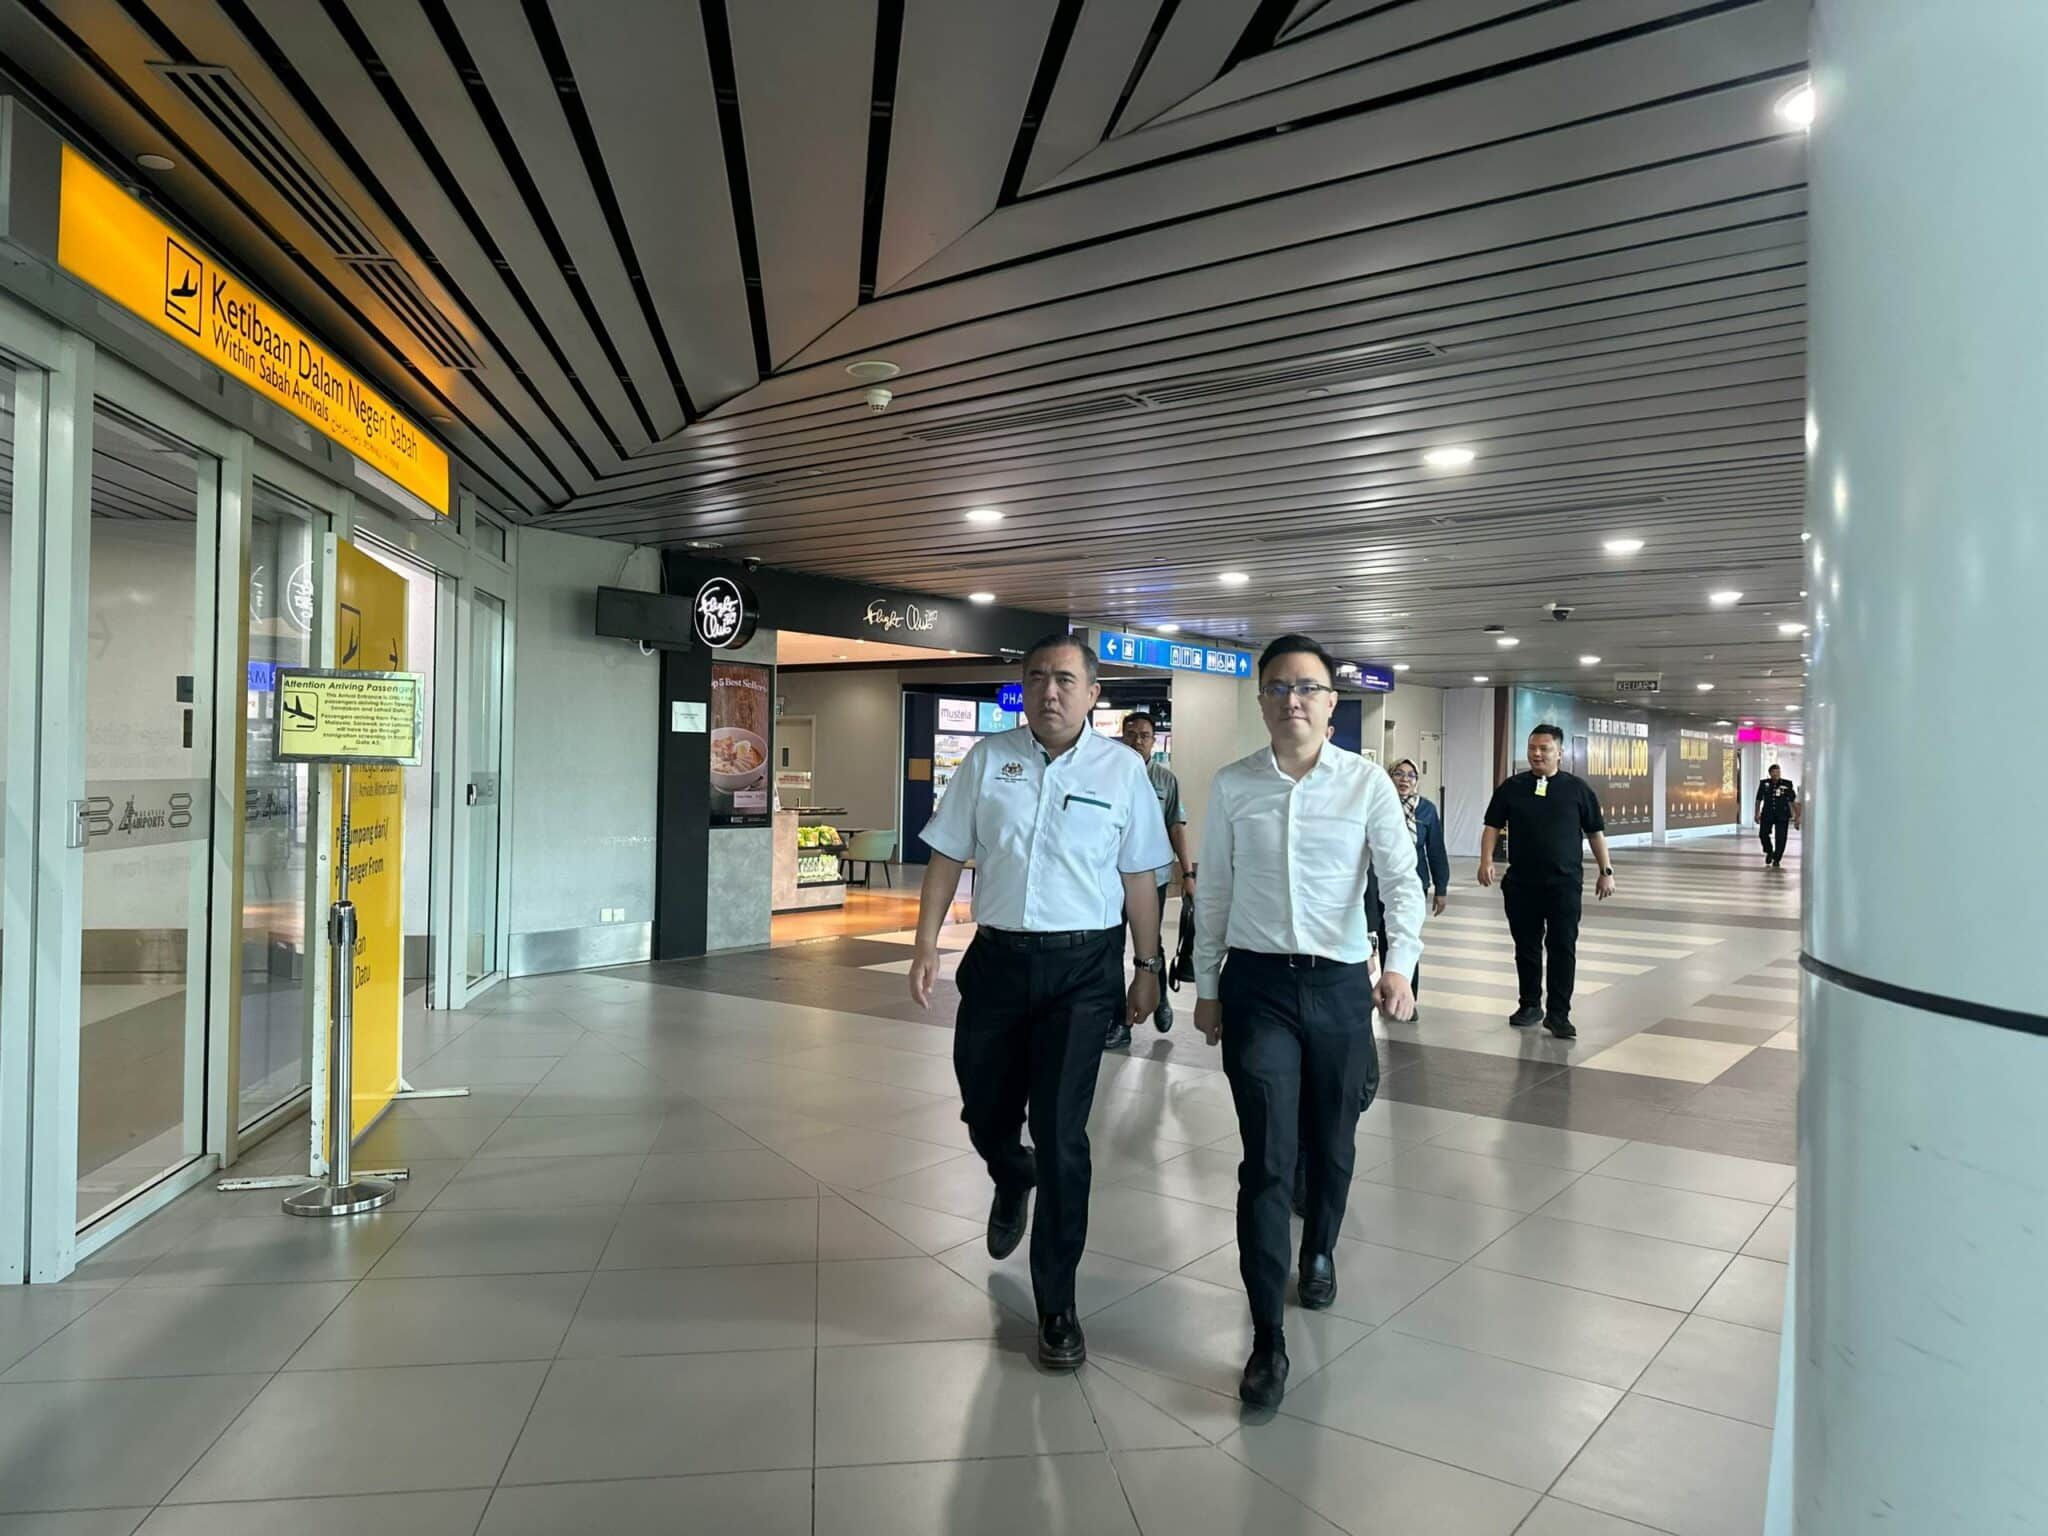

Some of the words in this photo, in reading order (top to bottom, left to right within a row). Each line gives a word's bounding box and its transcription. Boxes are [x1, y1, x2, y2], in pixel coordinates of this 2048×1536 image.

[212, 271, 292, 369] Ketibaan
[298, 339, 344, 407] Dalam
[348, 378, 388, 438] Negeri
[390, 414, 418, 463] Sabah
[212, 319, 256, 374] Within
[259, 354, 291, 397] Sabah
[292, 379, 329, 422] Arrivals
[698, 586, 739, 618] Flight
[862, 599, 904, 631] Flight
[284, 680, 326, 689] Attention
[328, 681, 364, 692] Arriving
[725, 678, 742, 688] Best
